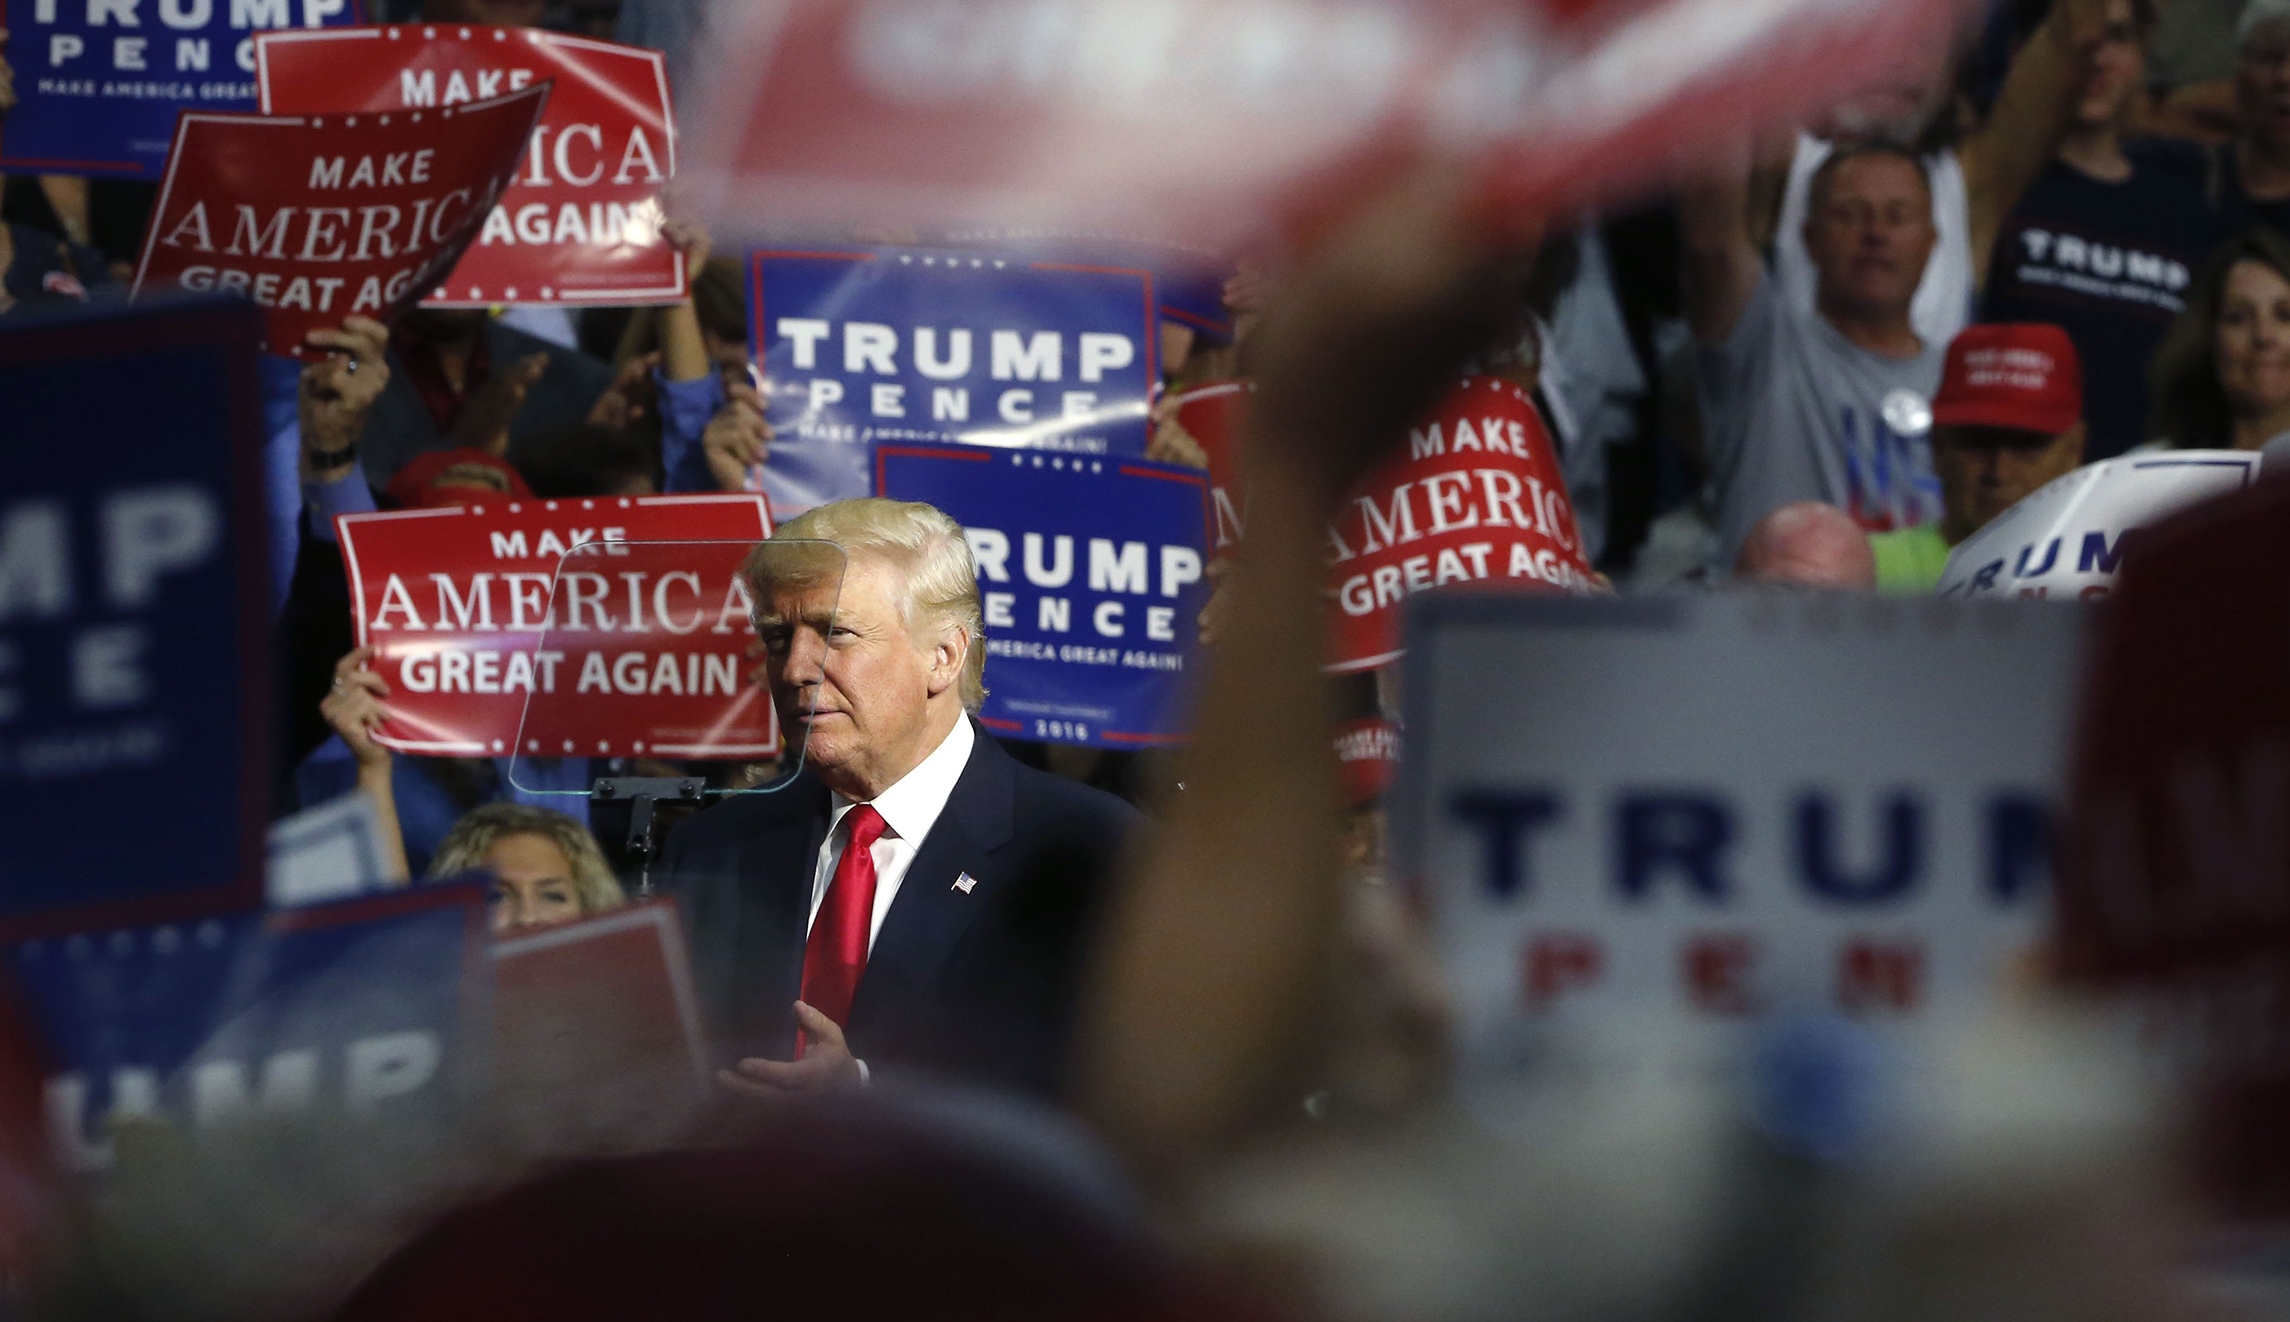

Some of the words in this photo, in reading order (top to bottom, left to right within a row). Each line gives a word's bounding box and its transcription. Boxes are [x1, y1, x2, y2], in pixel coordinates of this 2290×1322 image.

[49, 34, 258, 72] PENC
[38, 78, 97, 97] MAKE
[101, 81, 195, 100] AMERICA
[199, 82, 258, 100] GREA
[309, 149, 434, 190] MAKE
[2019, 227, 2190, 293] TRUMP
[179, 264, 345, 313] GREAT
[776, 317, 1134, 383] TRUMP
[808, 378, 1100, 425] PENCE
[1409, 416, 1530, 461] MAKE
[490, 526, 631, 559] MAKE
[964, 526, 1202, 598] RUMP
[1943, 529, 2124, 597] RUM
[369, 570, 757, 635] AMERICA
[1340, 543, 1494, 616] GREAT
[984, 592, 1175, 642] ENCE
[400, 650, 565, 693] GREAT
[577, 652, 738, 696] AGAIN
[983, 639, 1057, 662] MERICA
[1059, 644, 1118, 666] GREAT
[1035, 718, 1089, 741] 2016
[1446, 786, 2057, 910] TRU
[1522, 930, 1927, 1012] PEN
[40, 1028, 442, 1171] UMP
